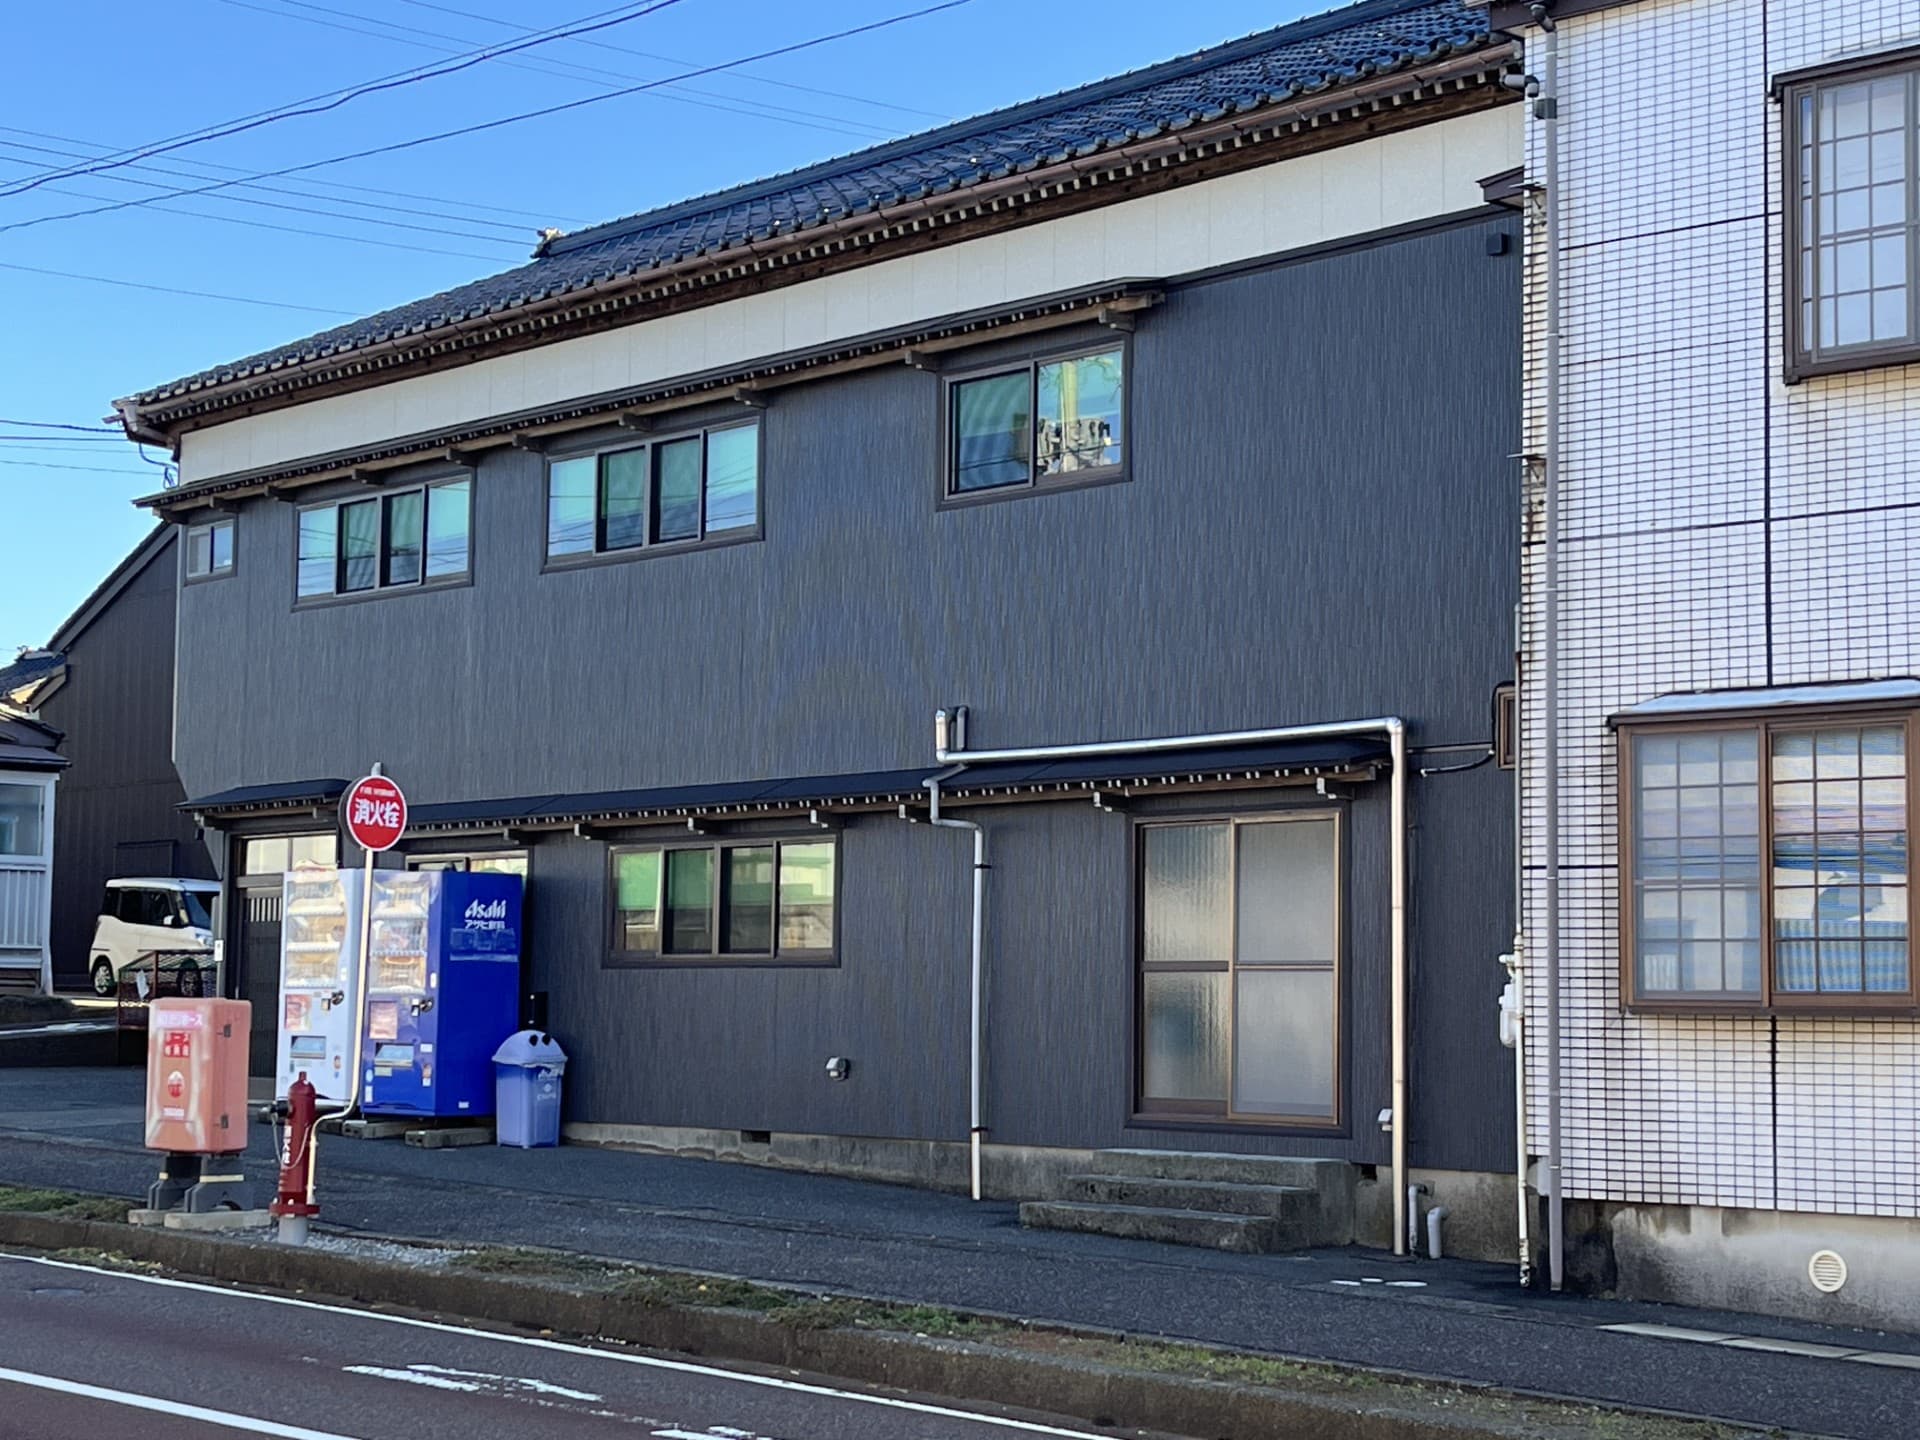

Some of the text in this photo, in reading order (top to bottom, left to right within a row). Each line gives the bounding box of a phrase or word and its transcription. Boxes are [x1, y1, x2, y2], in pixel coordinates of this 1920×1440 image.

[353, 797, 400, 828] 消火栓
[465, 898, 507, 919] Asahi
